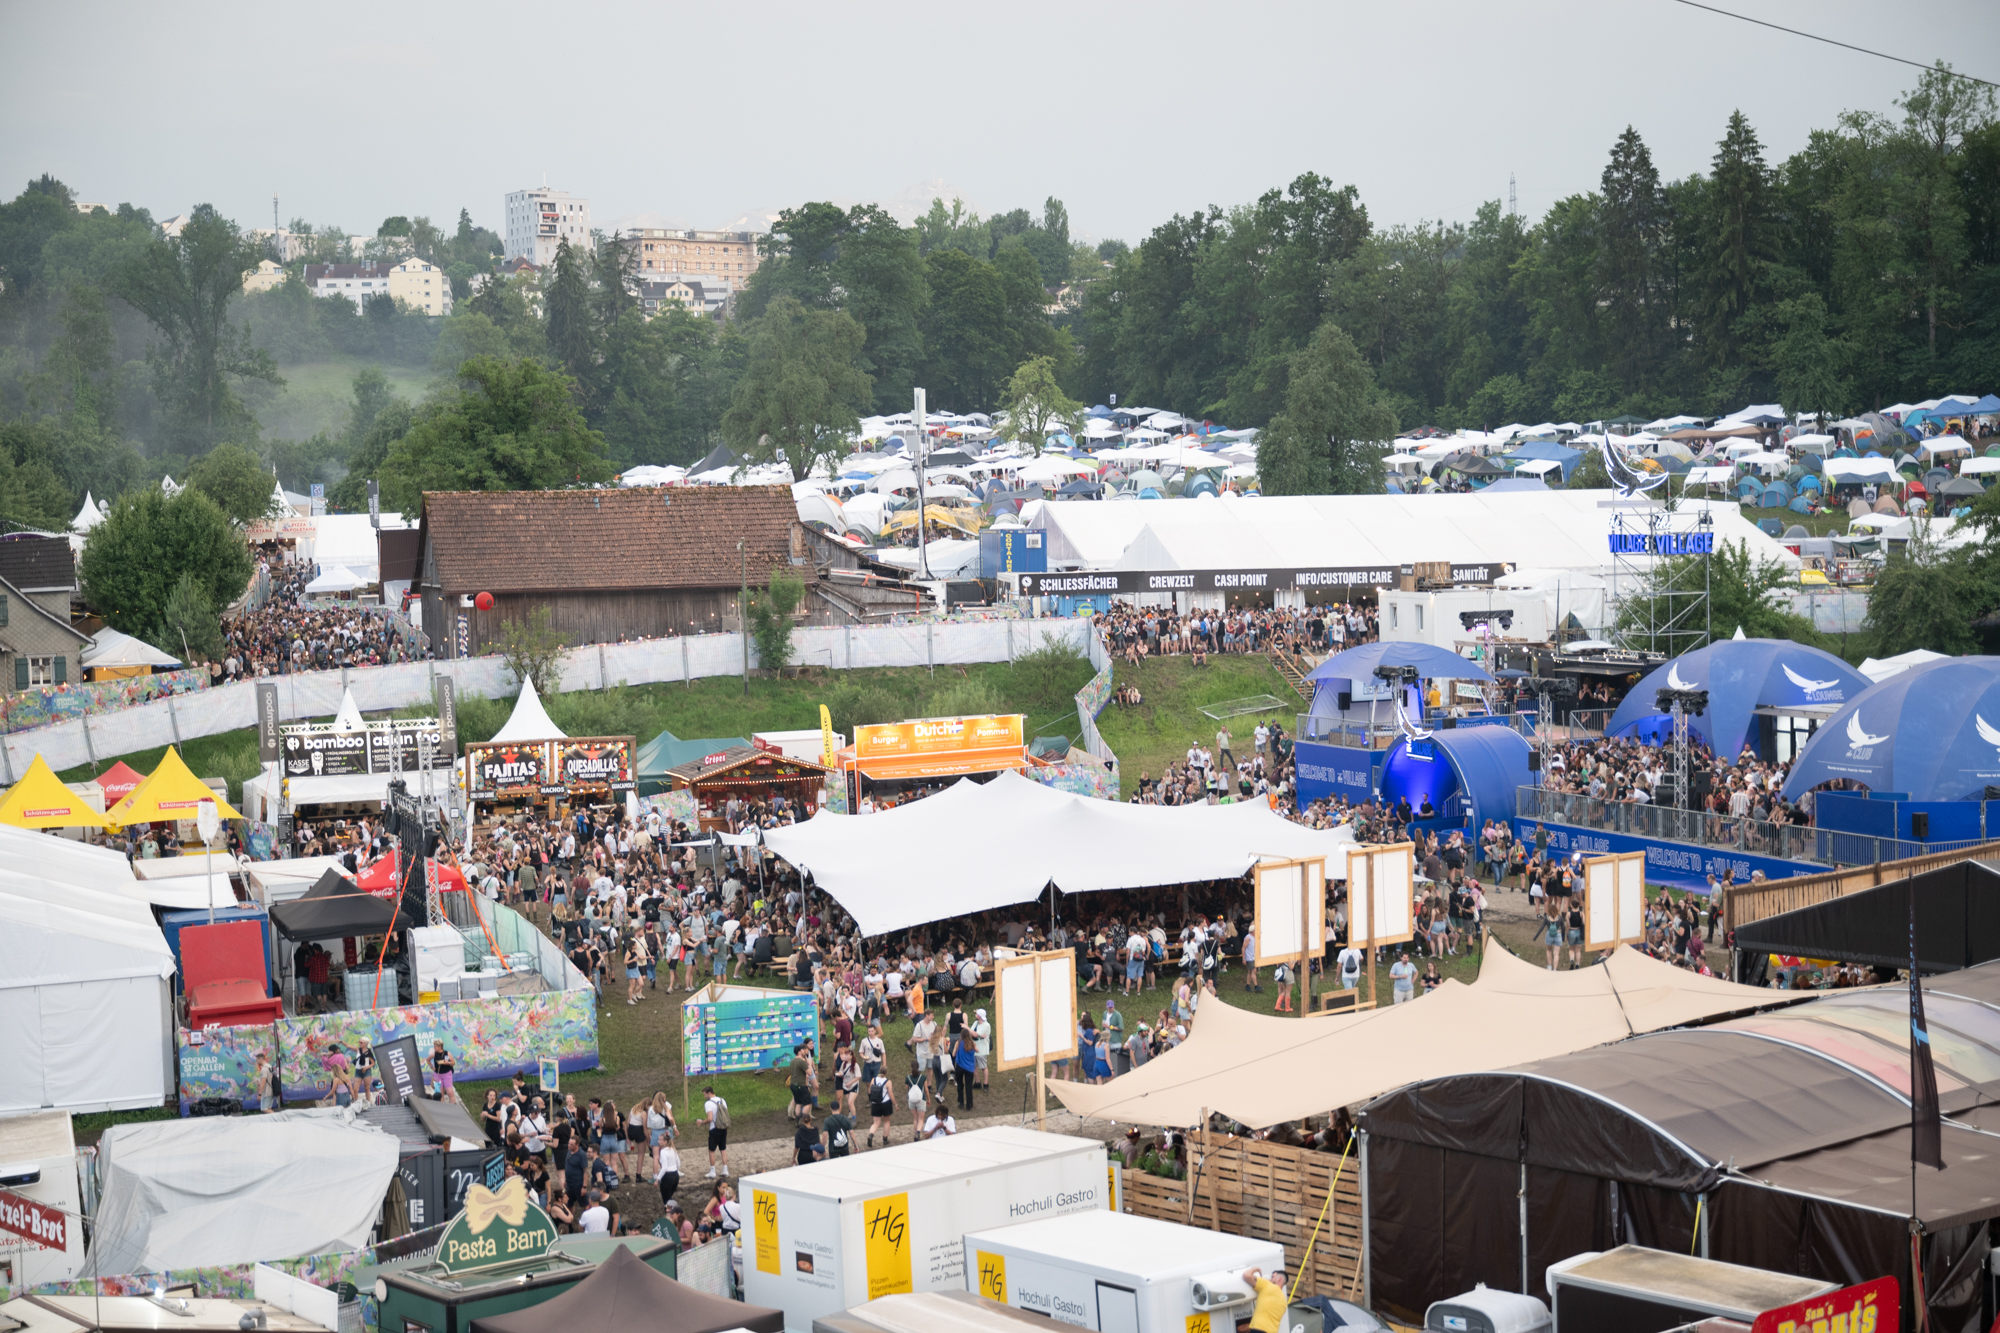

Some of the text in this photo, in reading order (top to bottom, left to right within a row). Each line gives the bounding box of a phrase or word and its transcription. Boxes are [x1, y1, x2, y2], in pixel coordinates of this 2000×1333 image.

[1608, 534, 1646, 553] VILLAGE
[1655, 532, 1713, 555] VILLAGE
[1149, 575, 1195, 588] CREWZELT
[1214, 573, 1268, 587] CASH POINT
[1296, 572, 1368, 585] INFO/CUSTOMER
[1369, 571, 1392, 583] CARE
[1452, 566, 1489, 581] SANITÄT
[1039, 575, 1118, 591] SCHLIESSFÄCHER
[1812, 689, 1845, 702] LOUNGE
[266, 691, 276, 736] bamboo
[444, 684, 455, 728] bamboo
[872, 734, 899, 745] Burger
[976, 727, 1010, 737] Pommes
[303, 733, 364, 750] bamboo
[704, 754, 726, 766] Crêpes
[1852, 746, 1873, 760] CLUB
[288, 759, 309, 767] KASSE
[484, 760, 537, 779] FAJITAS
[567, 758, 618, 776] QUESADILLAS
[1297, 763, 1336, 783] WELCOME TO
[1342, 769, 1367, 788] VILLAGE
[540, 786, 565, 794] NACHOS
[611, 781, 635, 790] GUACAMOLE
[24, 808, 71, 818] Schützengarten
[158, 801, 200, 810] Schützengarte
[1557, 831, 1568, 849] TO
[1577, 834, 1610, 853] VILLAGE
[1646, 846, 1702, 872] WELCOME TO
[690, 1033, 702, 1073] TIME TABLE
[192, 1063, 225, 1072] GALLEN
[388, 1047, 410, 1085] DOCH
[486, 1160, 505, 1187] ARSCH
[1009, 1189, 1094, 1217] Hochuli Gastro
[755, 1194, 776, 1232] HG
[867, 1206, 905, 1252] HG
[448, 1228, 548, 1264] Pasta Barn
[794, 1239, 832, 1254] Hochuli Gastro
[67, 1267, 72, 1275] 7
[870, 1275, 889, 1285] Pizzen
[871, 1279, 909, 1293] Flammkuchen
[980, 1262, 1003, 1301] HG
[1018, 1287, 1083, 1317] Hochuli Gastro
